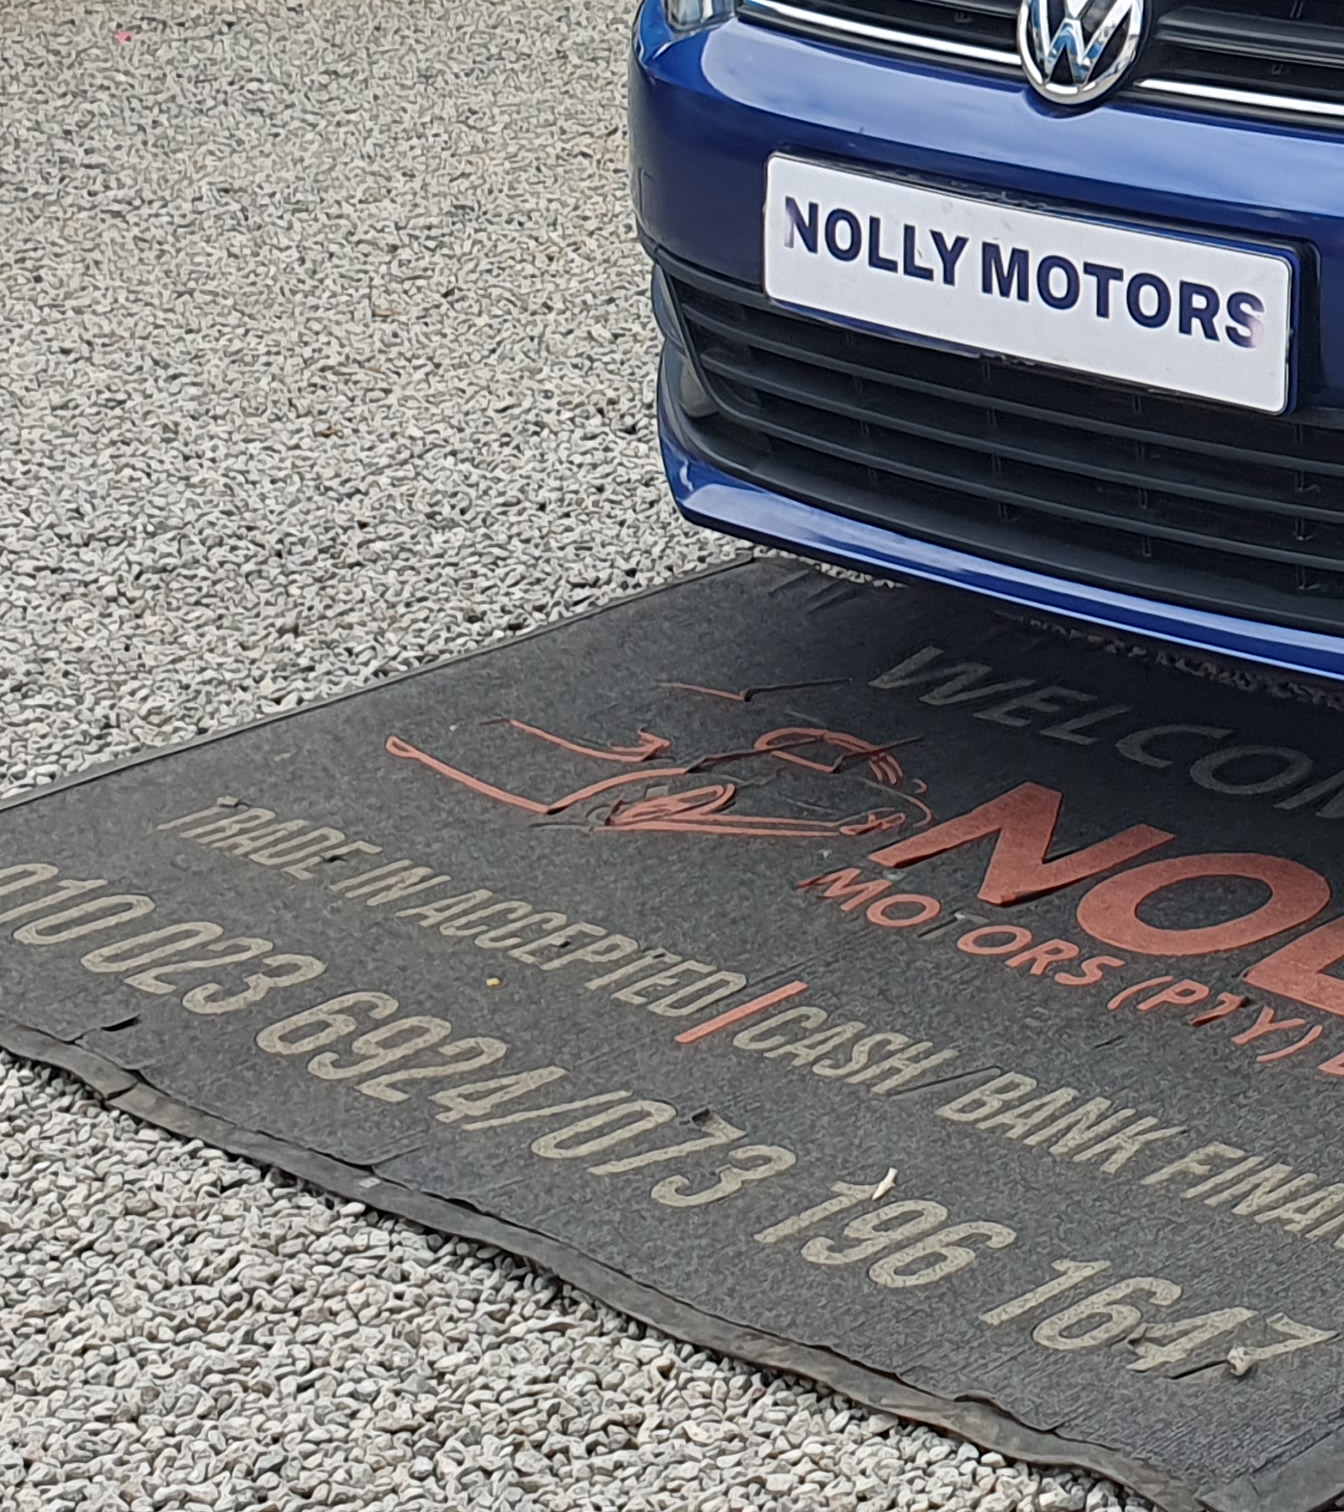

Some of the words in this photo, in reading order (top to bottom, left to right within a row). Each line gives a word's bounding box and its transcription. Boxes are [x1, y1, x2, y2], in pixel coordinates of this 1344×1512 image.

[783, 196, 970, 287] NOLLY
[981, 241, 1266, 350] MOTORS
[157, 795, 383, 880] TRADE
[329, 859, 451, 906] IN
[395, 888, 746, 1017] ACCEPTED
[935, 1070, 1188, 1173] BANK
[797, 868, 1125, 985] MOTORS
[1106, 975, 1324, 1063] (PTY)
[80, 921, 328, 1014] 023
[754, 1180, 1017, 1288] 196
[979, 1259, 1339, 1376] 1647
